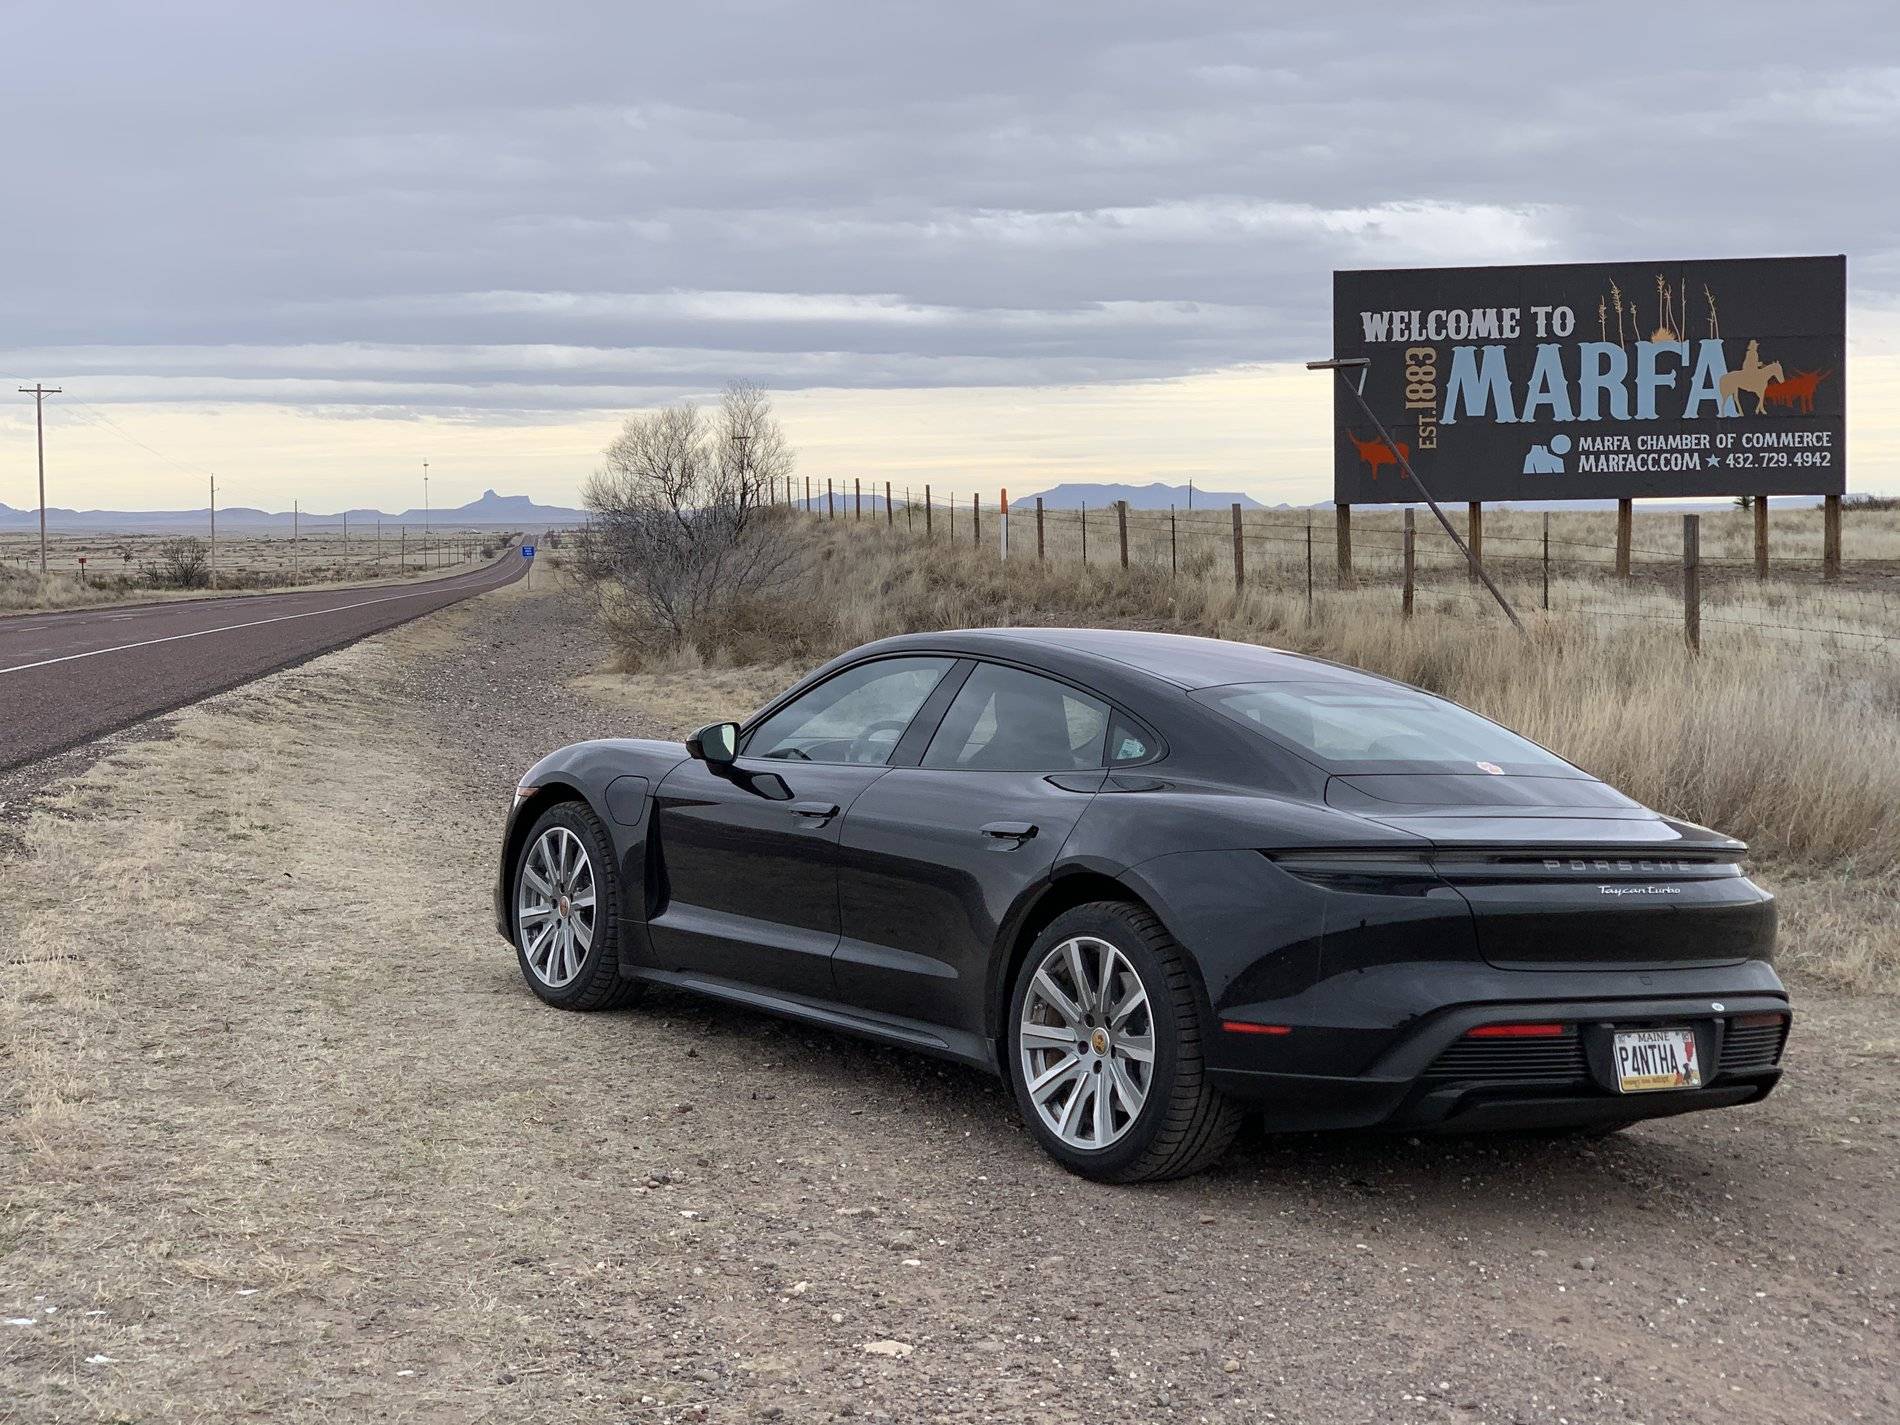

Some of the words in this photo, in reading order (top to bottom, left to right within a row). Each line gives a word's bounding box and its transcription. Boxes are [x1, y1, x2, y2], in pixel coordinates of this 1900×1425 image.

[1359, 306, 1521, 343] WELCOME
[1530, 305, 1576, 338] TO
[1439, 338, 1739, 425] MARFA
[1578, 436, 1631, 452] MARFA
[1637, 434, 1710, 450] CHAMBER
[1716, 433, 1736, 448] OF
[1742, 431, 1832, 448] COMMERCE
[1578, 452, 1702, 473] MARFACC.COM
[1725, 452, 1832, 468] 432.729.4942
[1543, 860, 1692, 871] PORSCHE
[1598, 885, 1645, 897] Taycan
[1638, 1032, 1670, 1043] MAINE
[1618, 1044, 1680, 1077] P4NTHA
